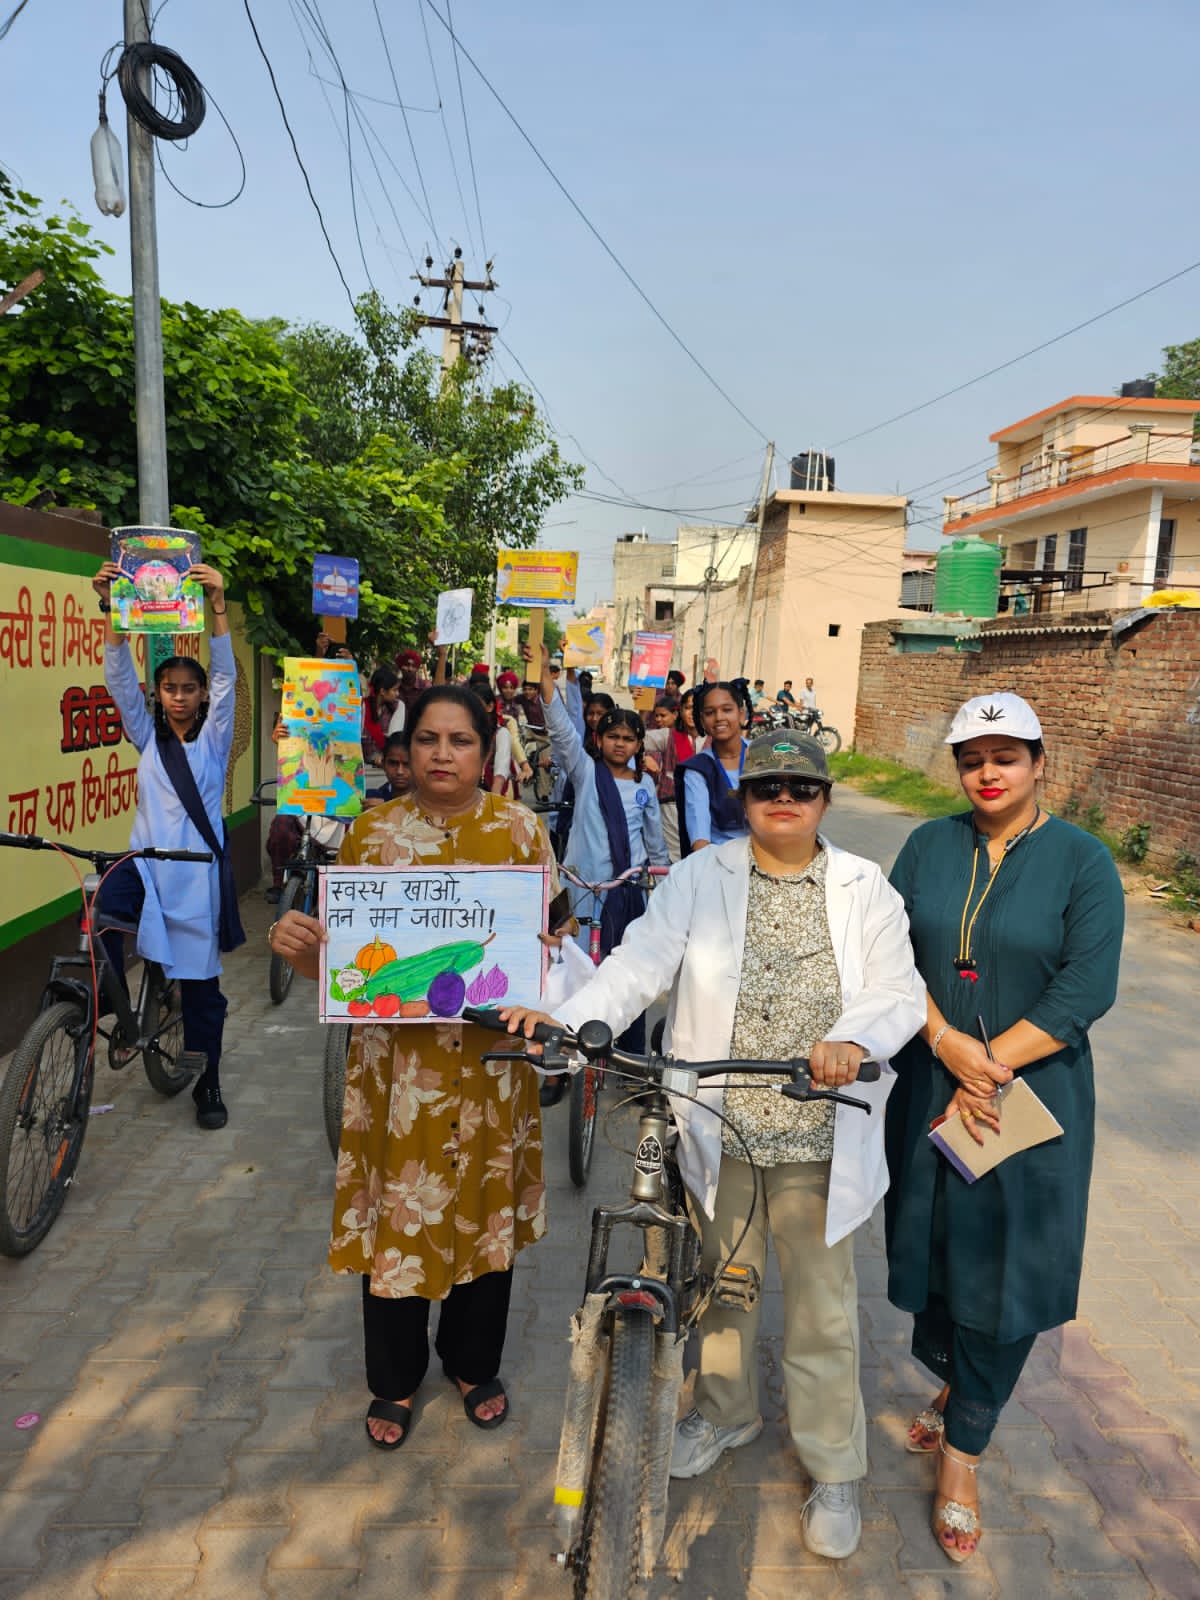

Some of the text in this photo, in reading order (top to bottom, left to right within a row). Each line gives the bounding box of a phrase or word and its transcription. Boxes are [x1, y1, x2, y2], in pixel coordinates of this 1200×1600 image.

[39, 592, 56, 667] ਵੀ
[330, 880, 388, 901] स्वस्थ
[328, 900, 495, 933] तन मन जगाओ!
